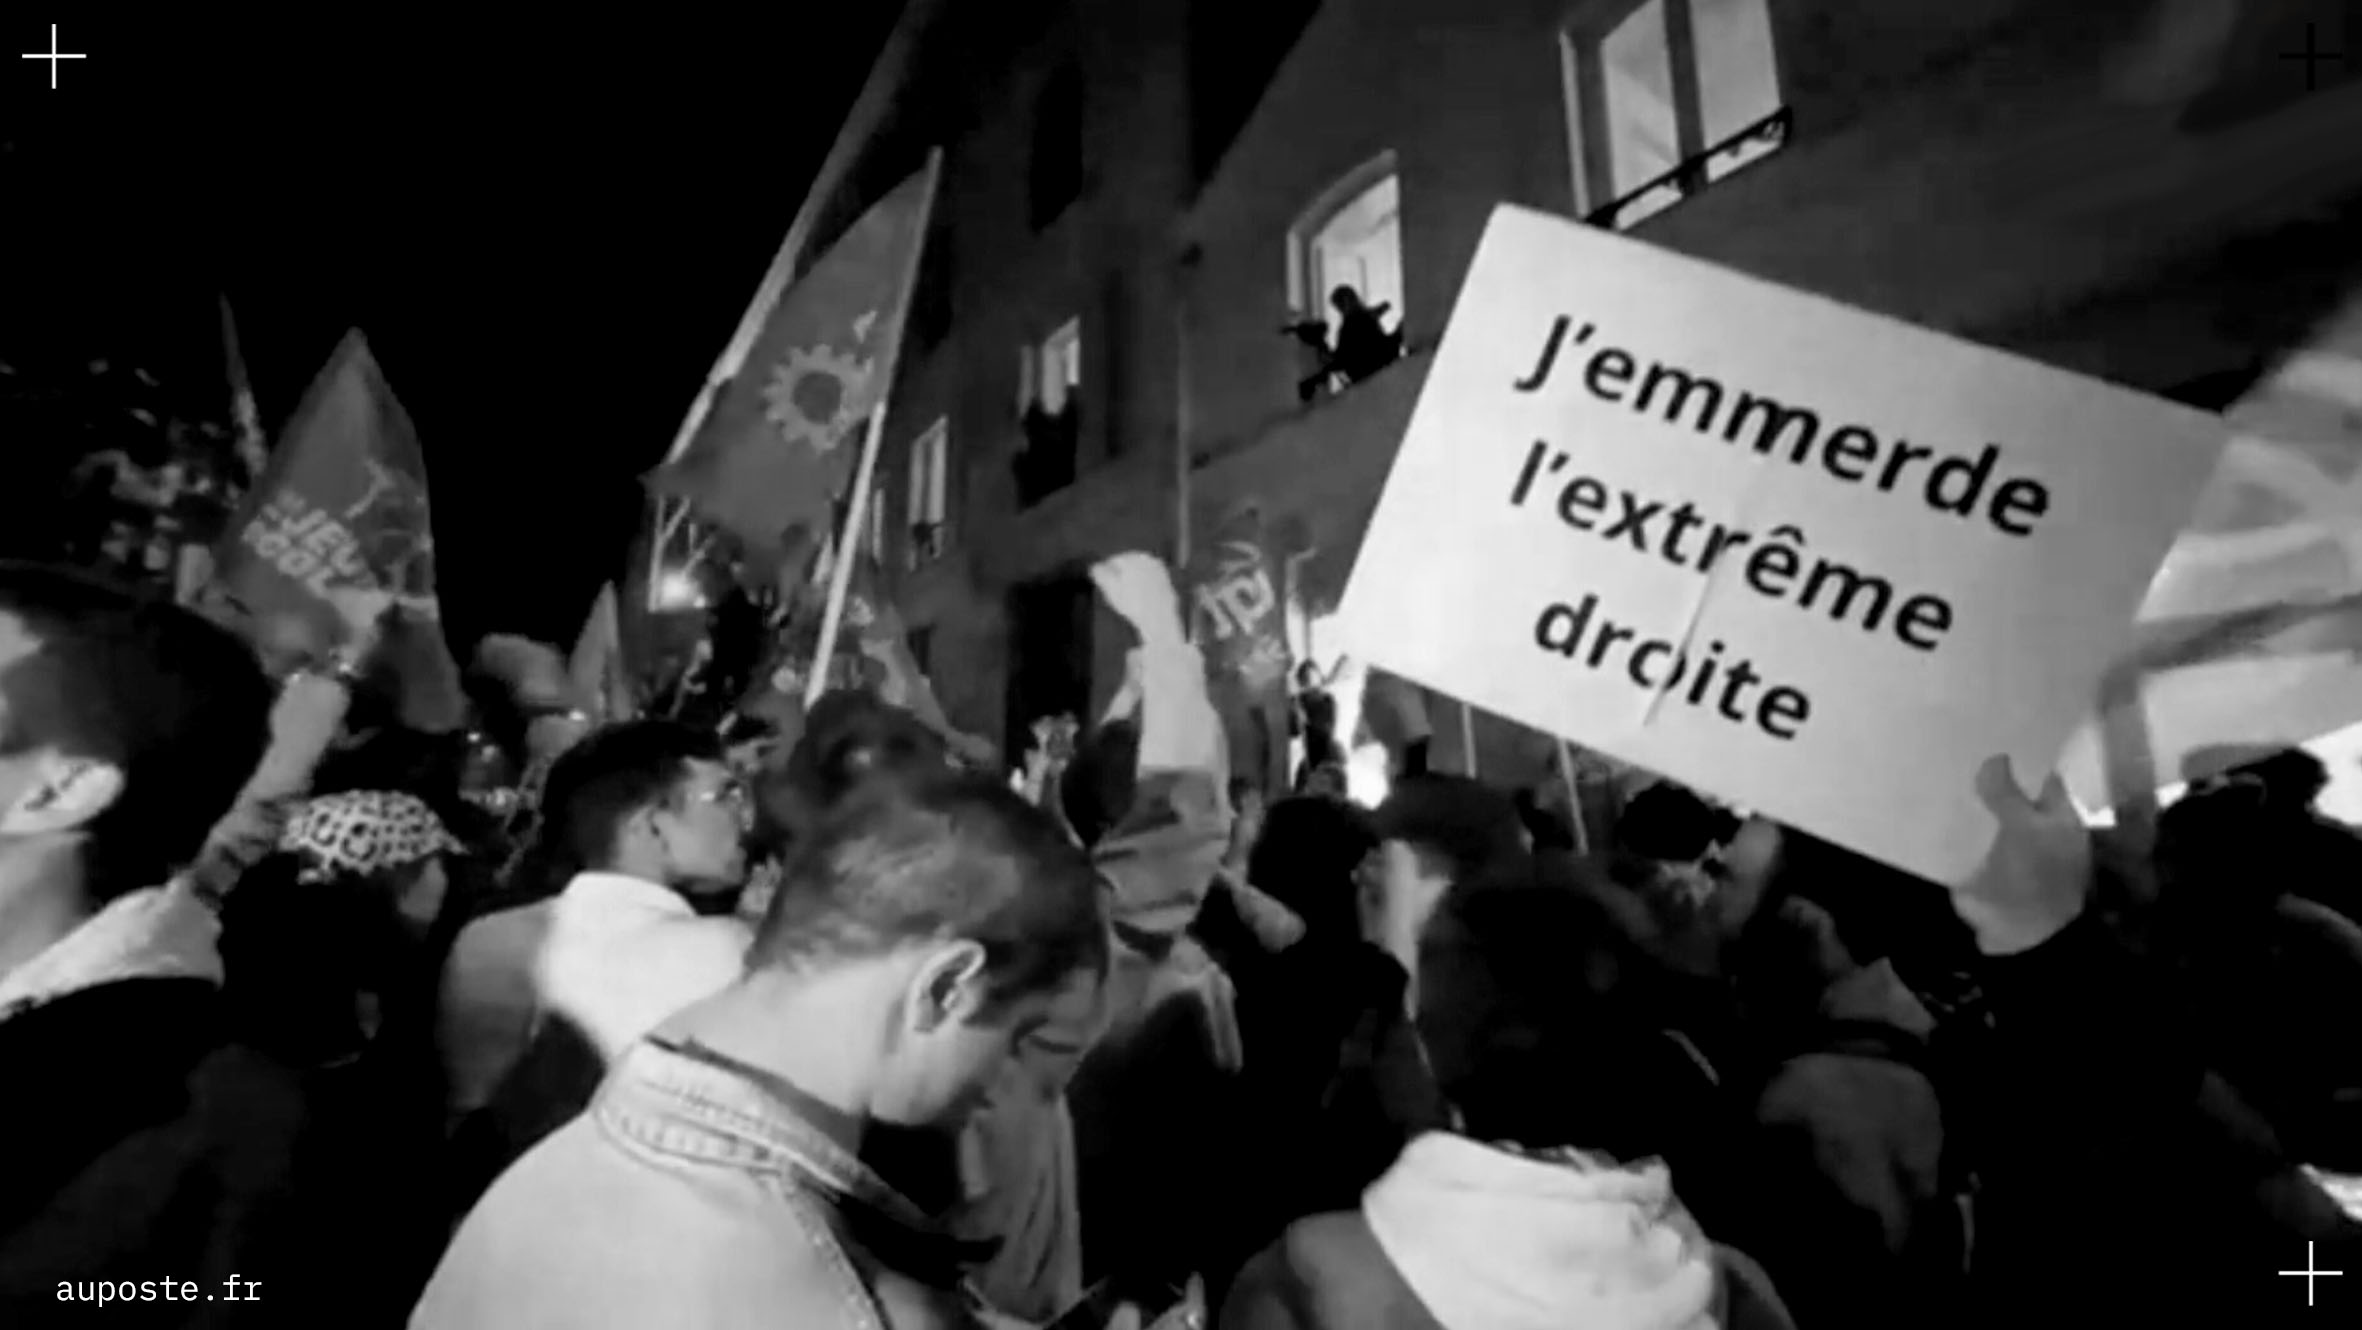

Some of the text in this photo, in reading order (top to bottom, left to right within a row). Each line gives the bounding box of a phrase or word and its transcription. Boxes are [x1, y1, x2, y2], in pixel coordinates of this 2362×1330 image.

[1514, 315, 2051, 537] J'emmerde
[1510, 440, 1953, 652] l'extrême
[1534, 594, 1811, 741] droite
